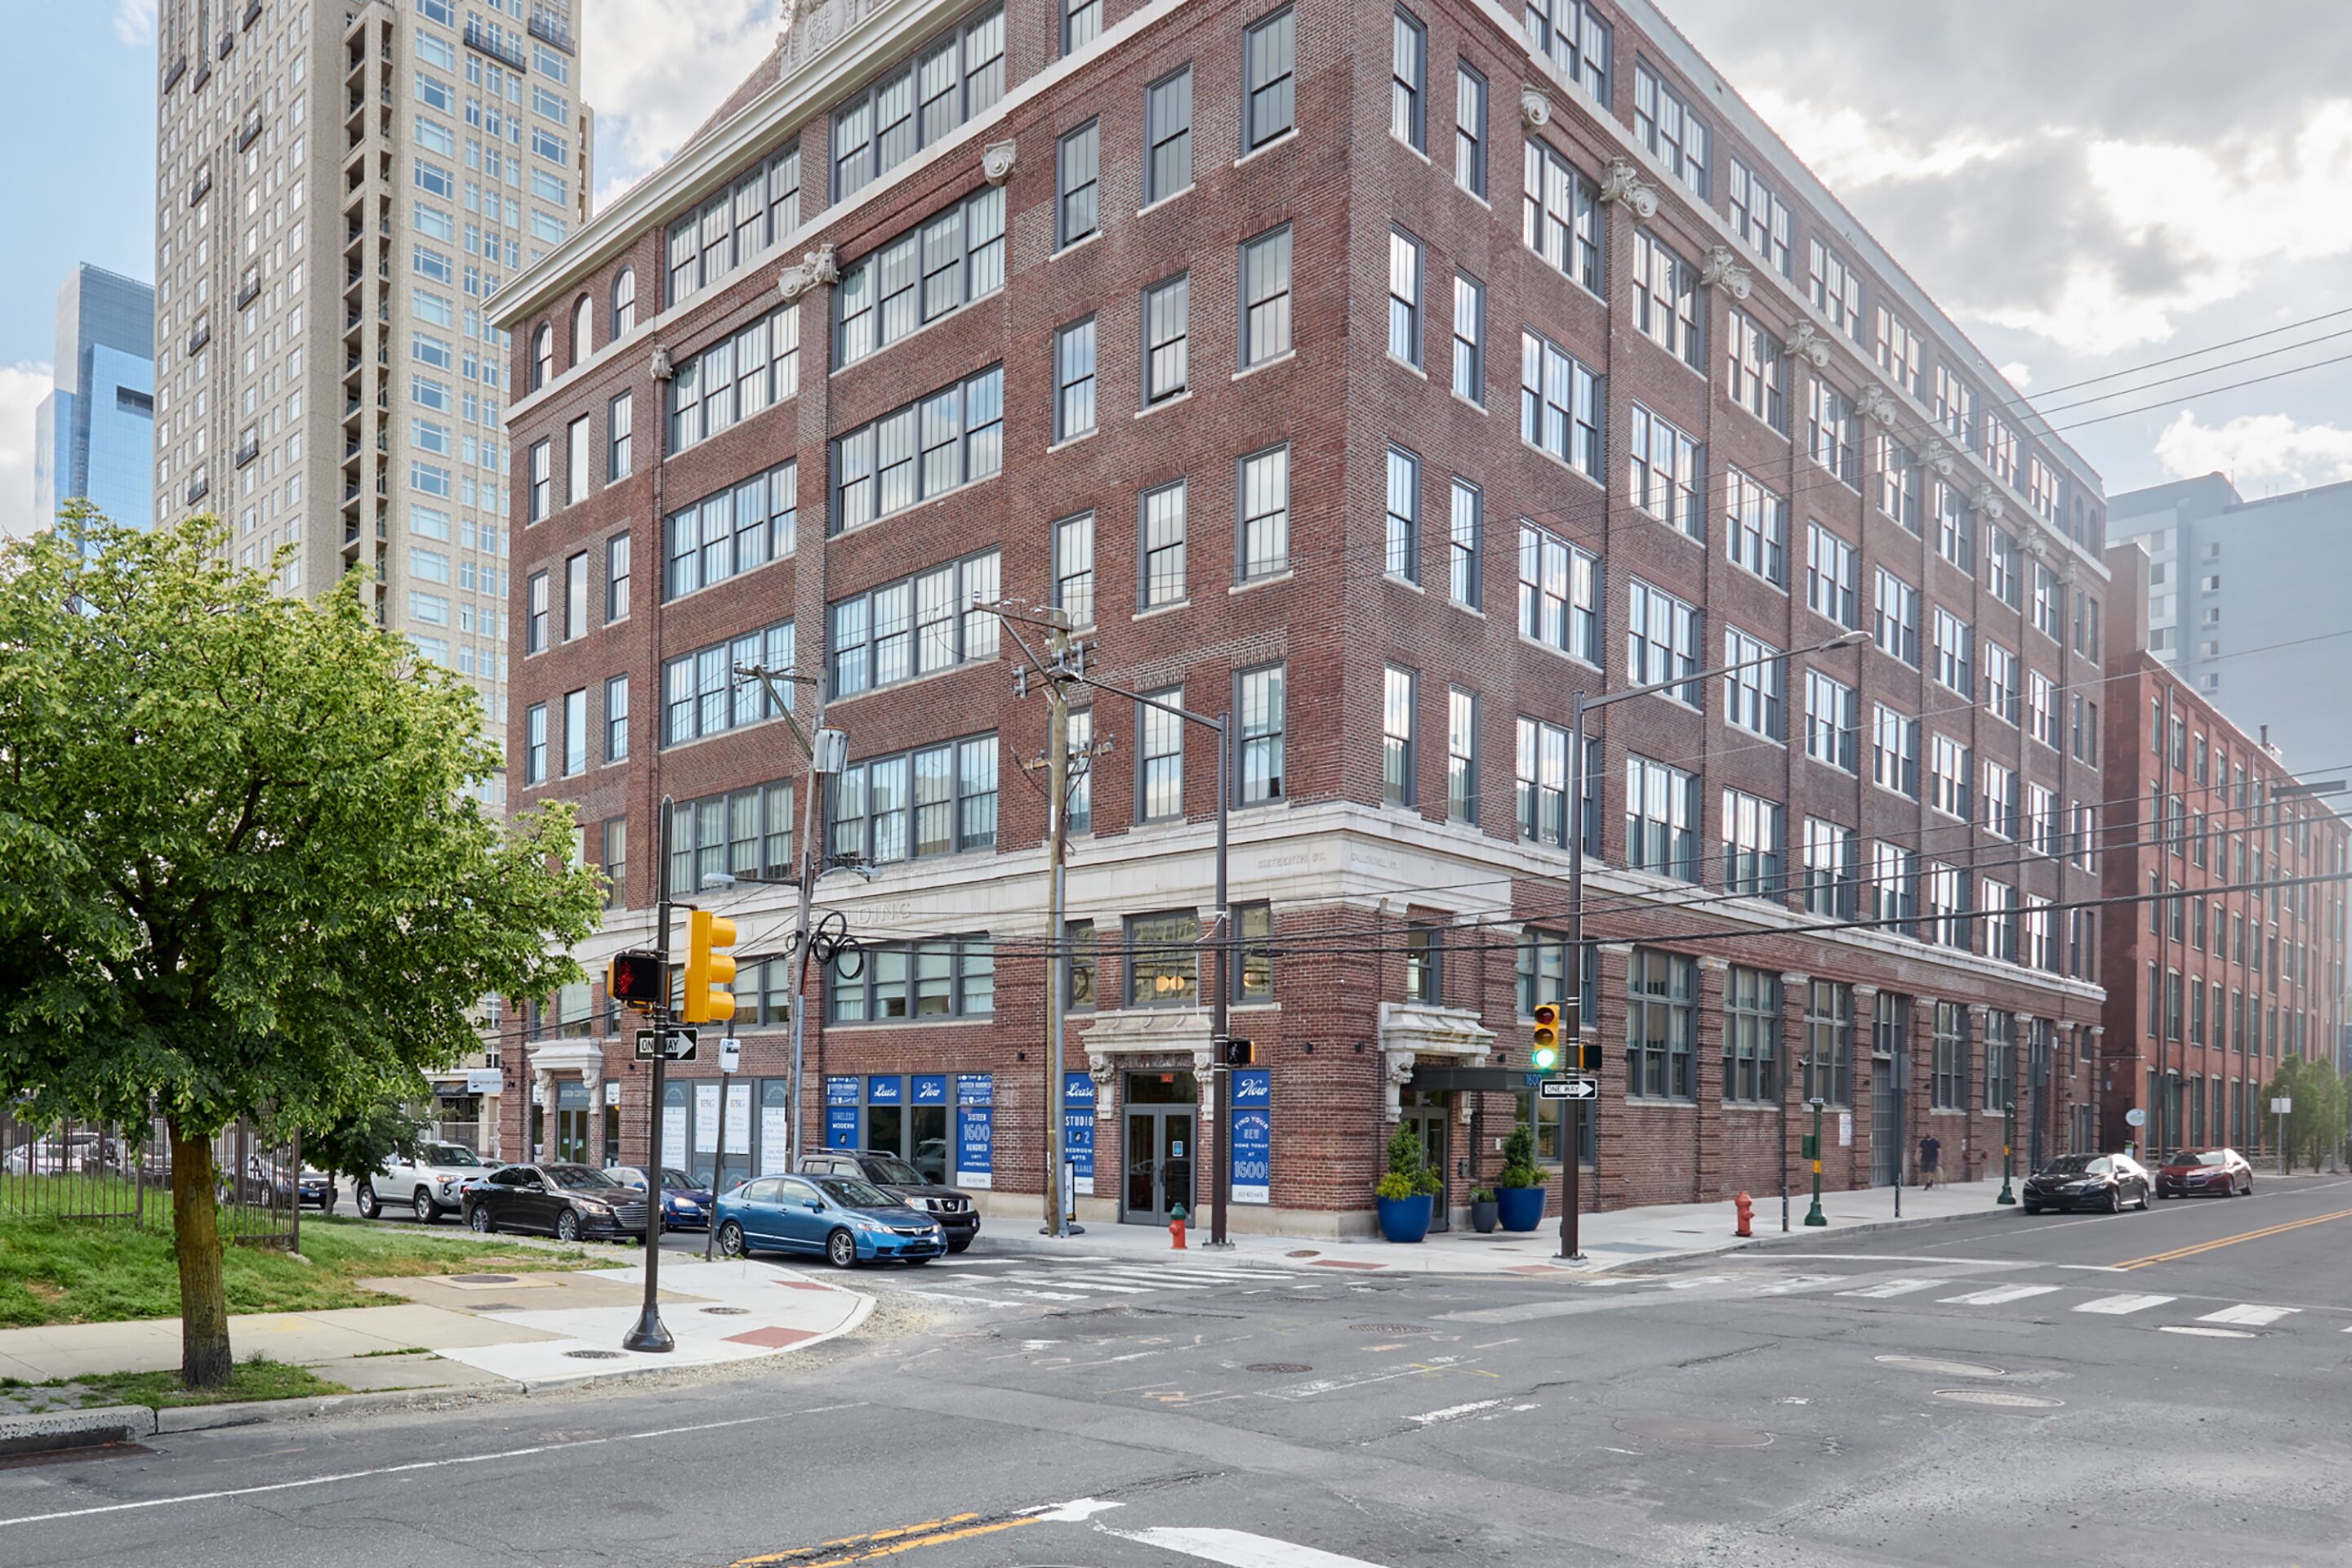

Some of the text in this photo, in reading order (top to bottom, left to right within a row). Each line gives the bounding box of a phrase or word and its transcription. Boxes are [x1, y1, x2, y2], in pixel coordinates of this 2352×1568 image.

[642, 1040, 679, 1051] ON AY
[874, 1084, 897, 1097] Lease
[920, 1081, 941, 1098] Now
[1066, 1082, 1094, 1098] Lease
[1236, 1079, 1267, 1098] Now
[1546, 1085, 1579, 1094] ONE WAY
[1065, 1116, 1094, 1127] STUDIO
[1234, 1116, 1268, 1130] FIND YOUR
[964, 1124, 990, 1142] 1600
[1067, 1131, 1072, 1143] 1
[1085, 1131, 1090, 1143] 2
[1243, 1129, 1259, 1139] NEW
[966, 1143, 987, 1152] HUNDRED
[1234, 1160, 1265, 1178] 1600
